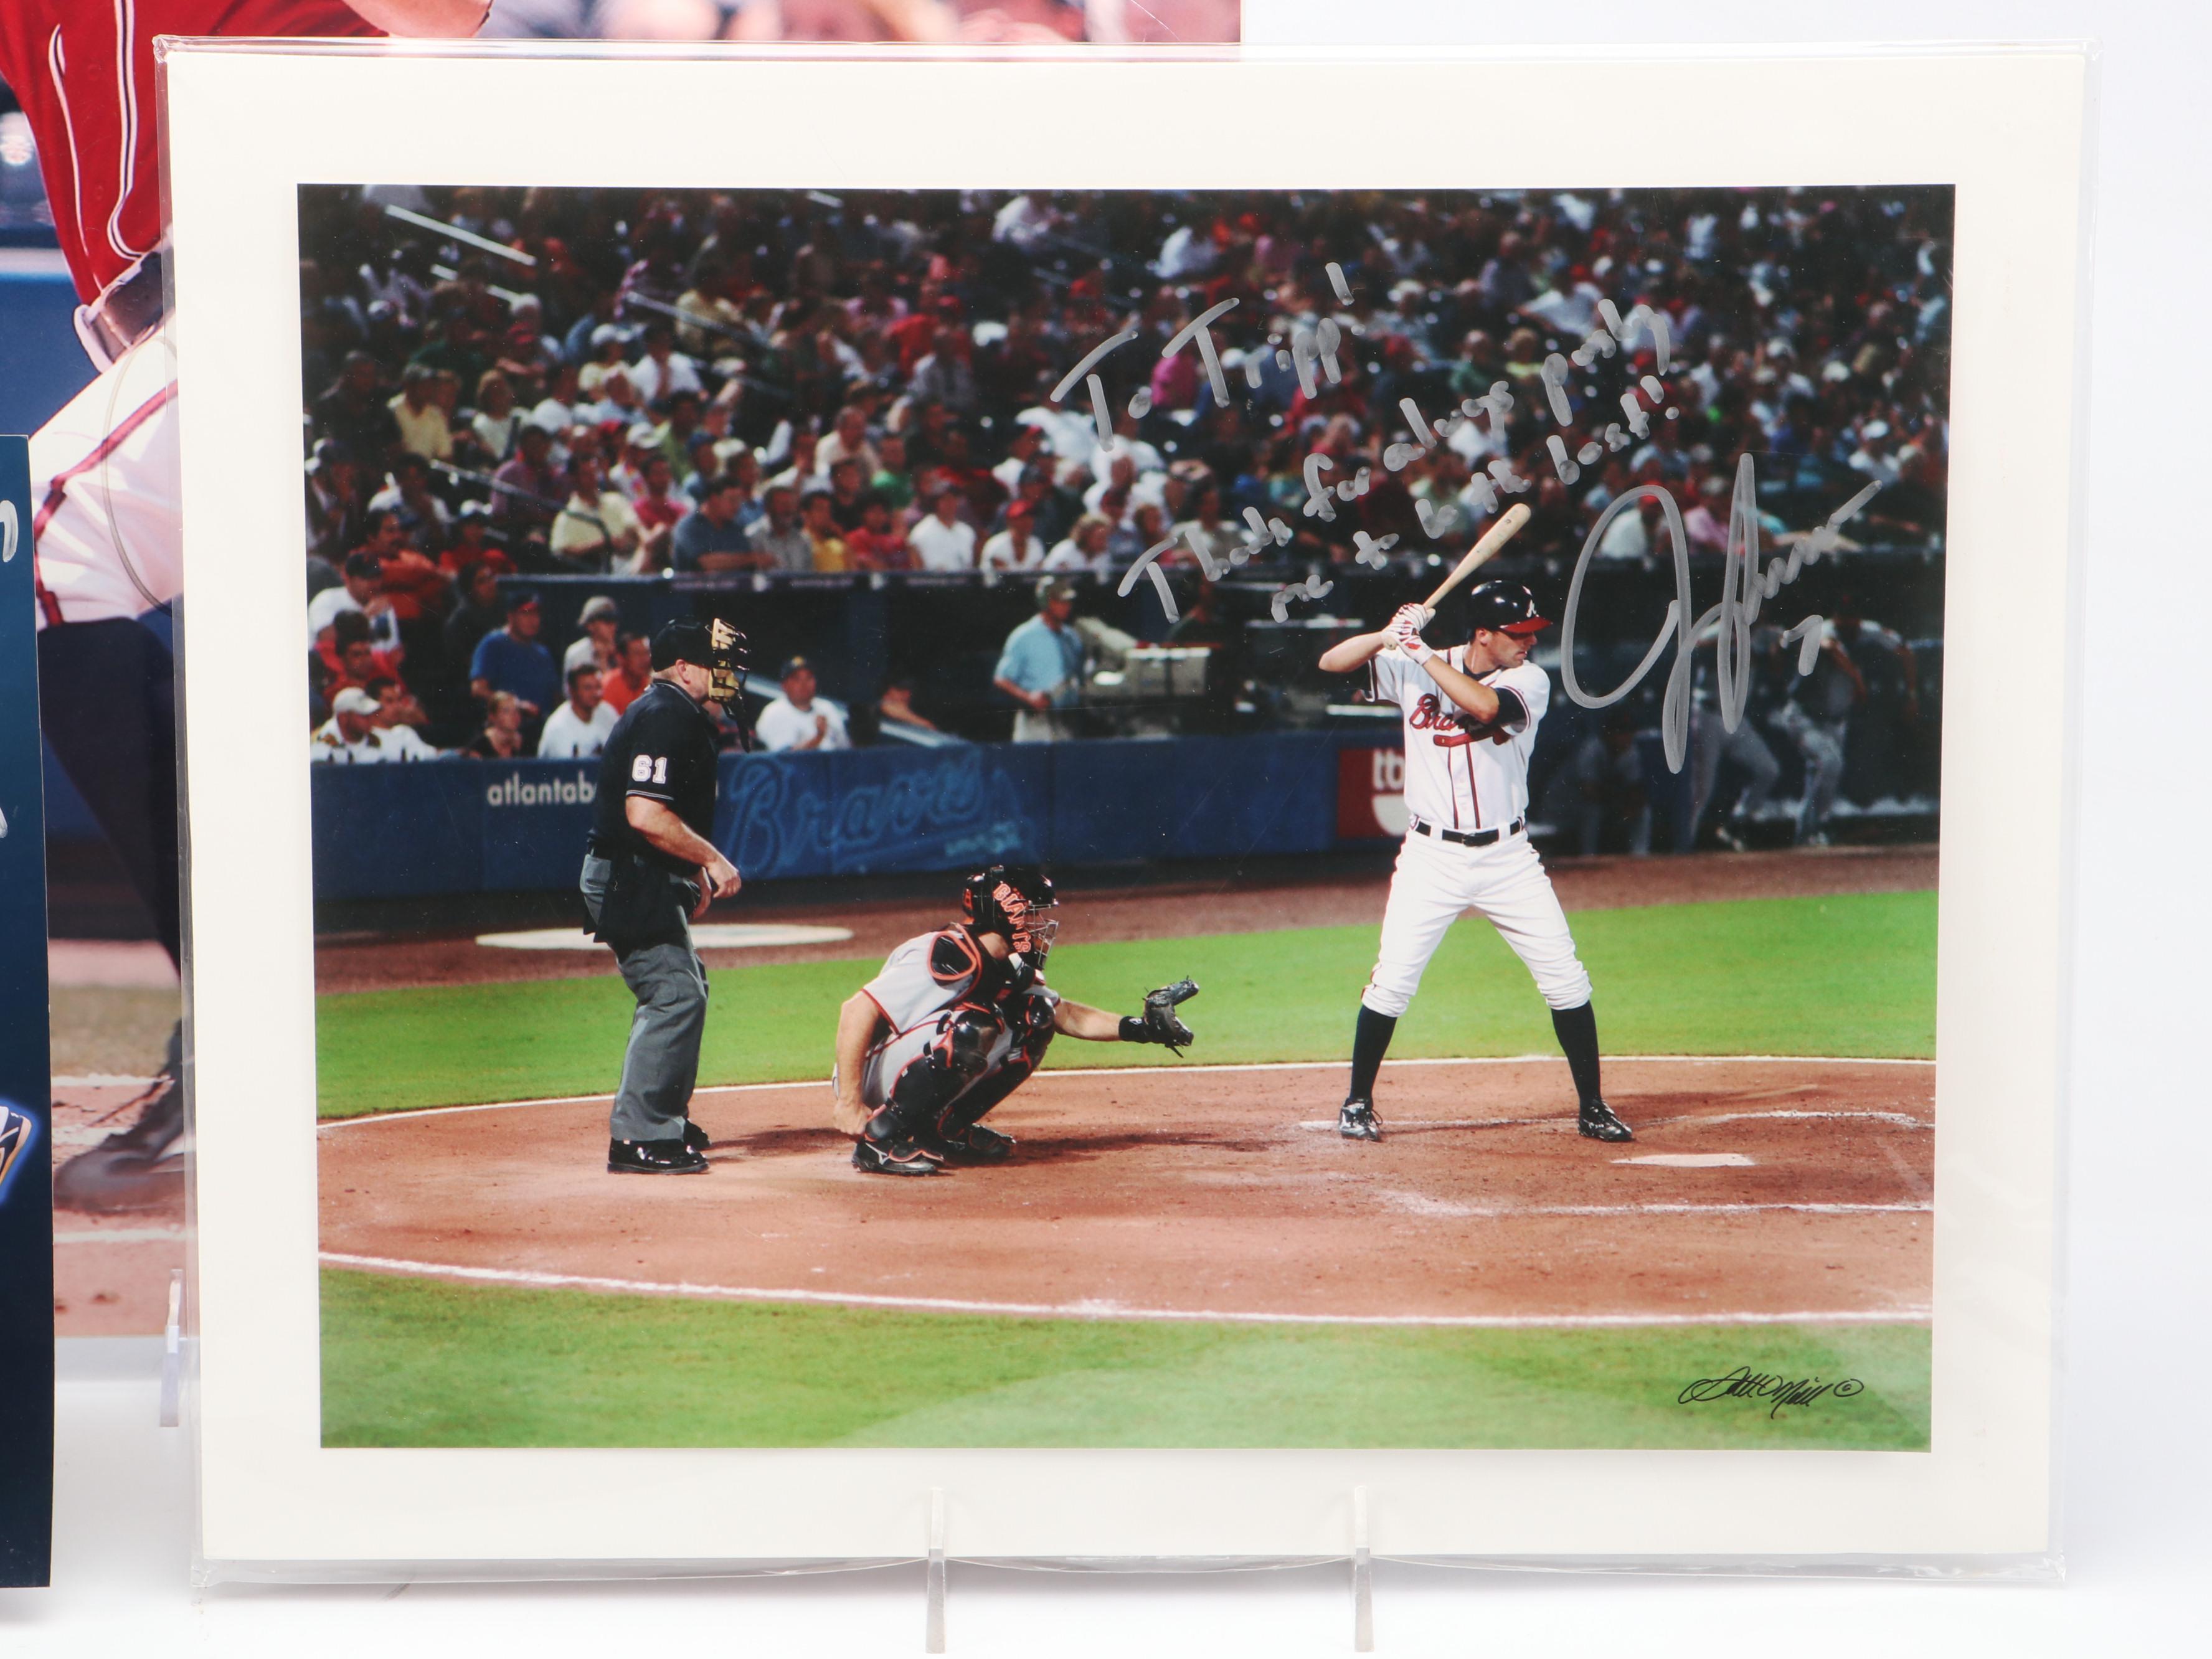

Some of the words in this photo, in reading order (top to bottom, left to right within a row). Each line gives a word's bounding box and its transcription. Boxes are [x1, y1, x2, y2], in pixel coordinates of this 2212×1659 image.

[1050, 329, 1151, 452] To
[1303, 452, 1370, 522] for
[1271, 574, 1335, 623] me
[1353, 530, 1400, 570] to
[486, 771, 597, 808] atlantab
[631, 754, 668, 785] 61
